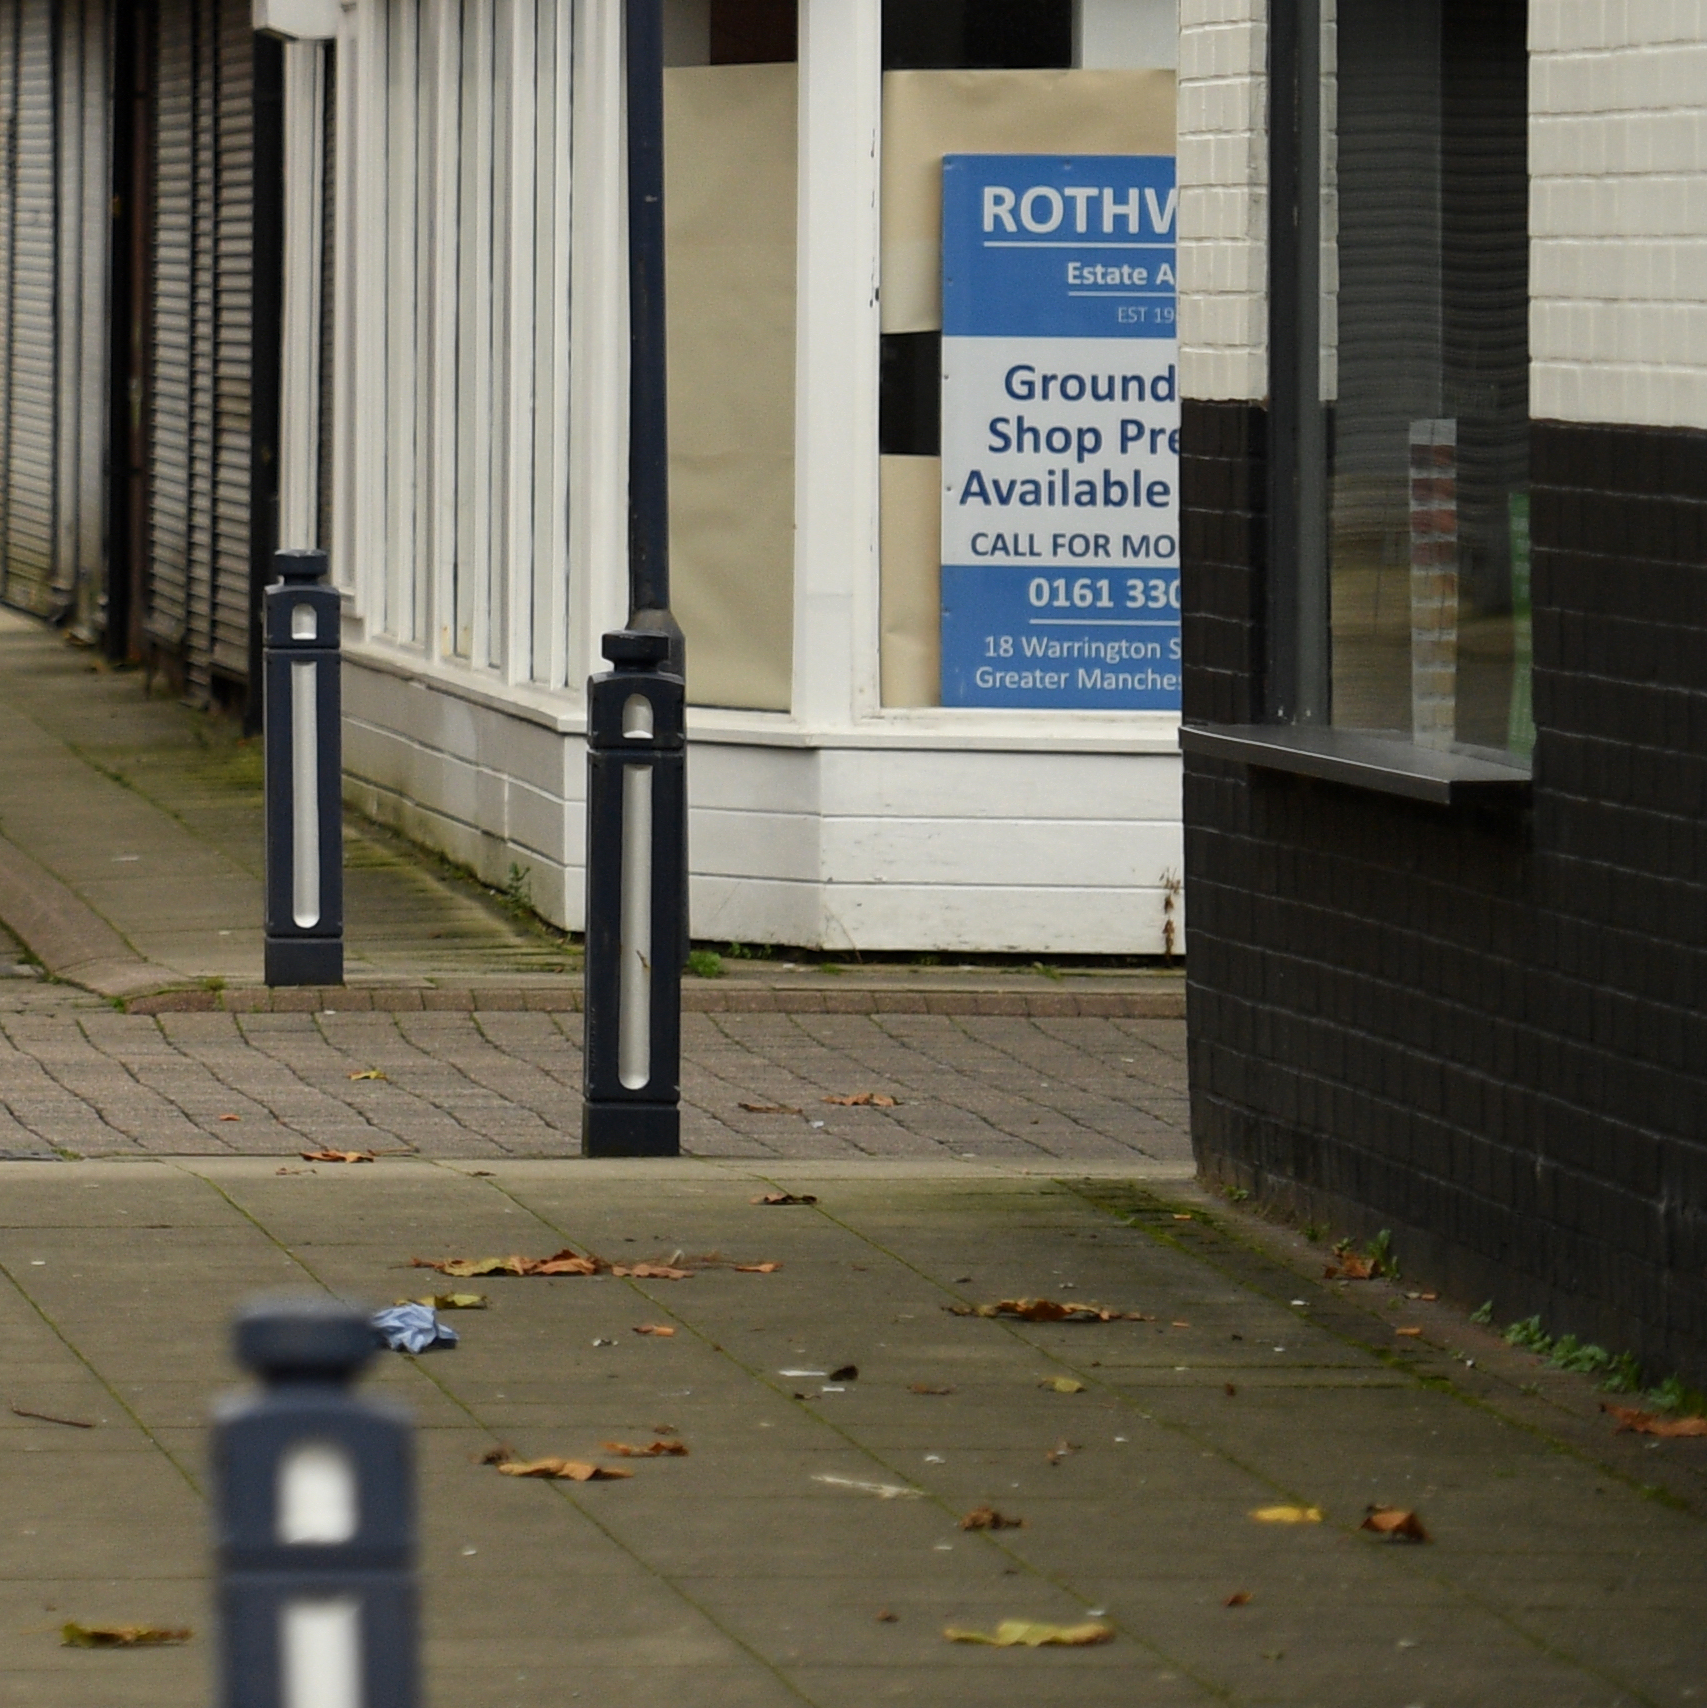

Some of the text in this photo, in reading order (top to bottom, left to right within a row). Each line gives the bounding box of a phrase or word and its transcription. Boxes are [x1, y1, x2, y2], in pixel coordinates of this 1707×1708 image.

[1067, 261, 1148, 286] Estate
[1117, 306, 1175, 324] EST 19
[1004, 363, 1176, 403] Ground
[987, 415, 1103, 464] Shop
[958, 467, 1172, 508] Available
[970, 531, 1177, 560] CALL FOR MO
[1028, 577, 1115, 609] 0161
[984, 635, 1014, 659] 18
[1021, 635, 1162, 665] Warrington
[974, 666, 1182, 691] Greater Manche
